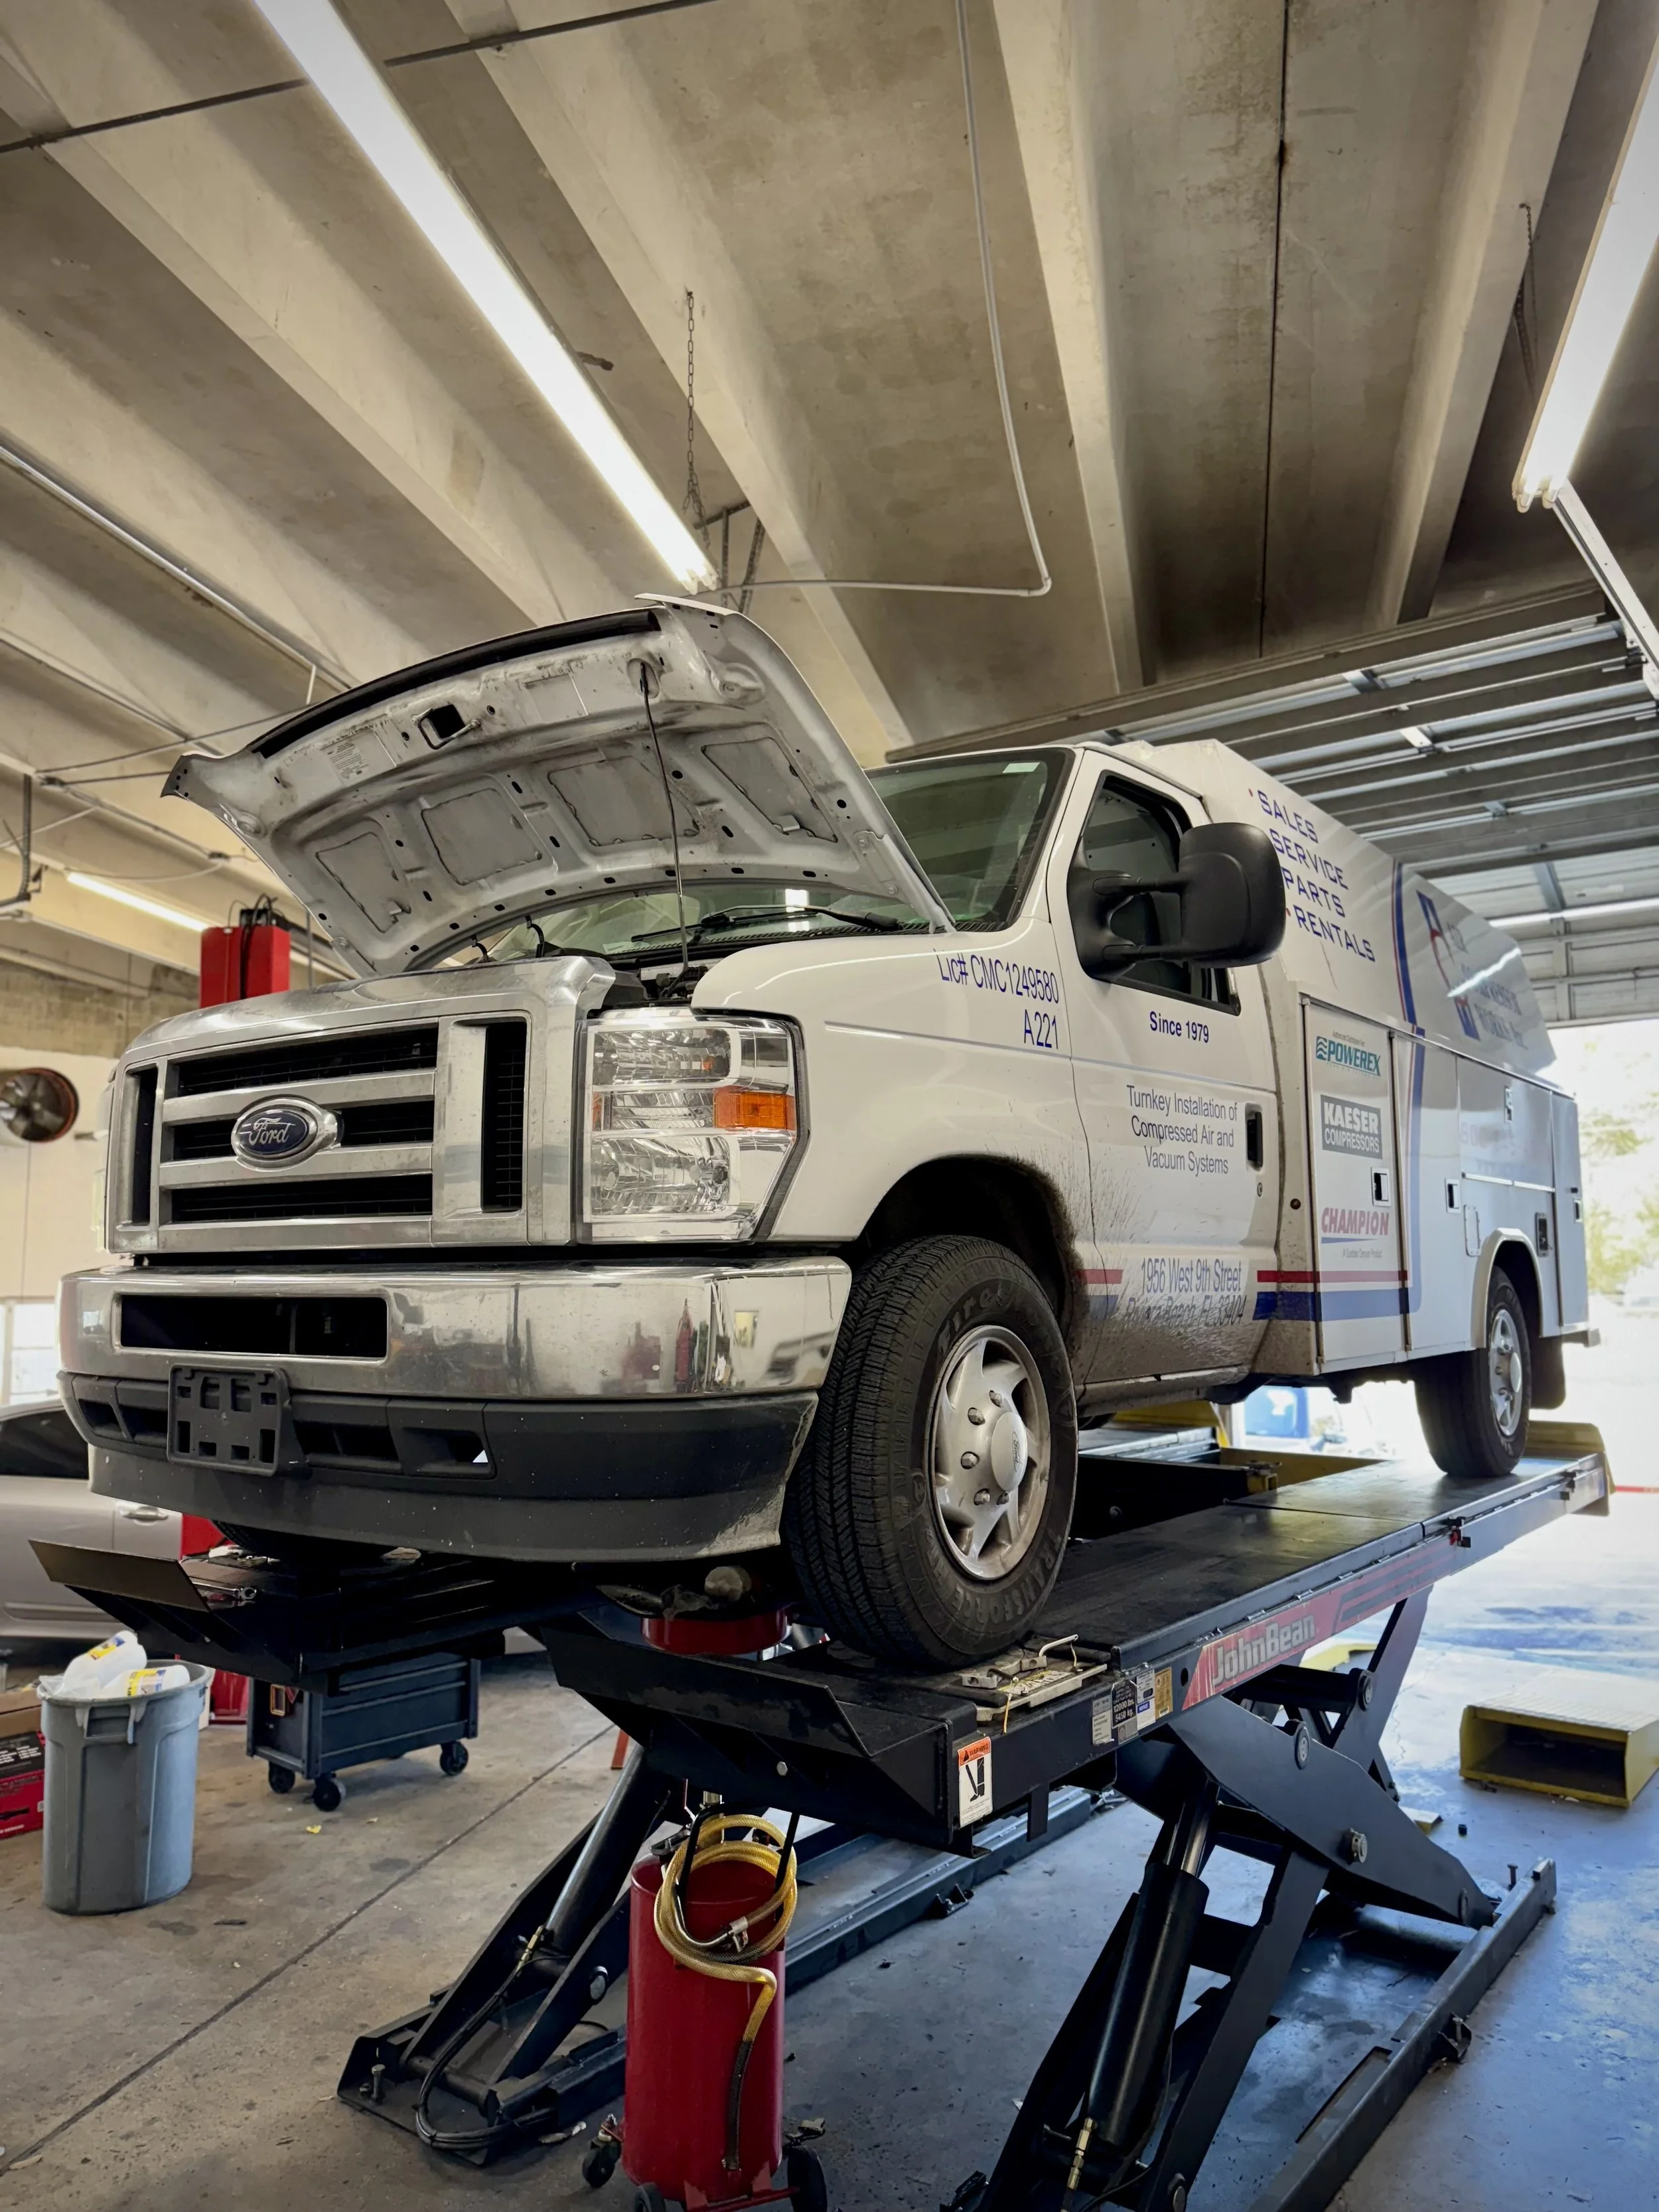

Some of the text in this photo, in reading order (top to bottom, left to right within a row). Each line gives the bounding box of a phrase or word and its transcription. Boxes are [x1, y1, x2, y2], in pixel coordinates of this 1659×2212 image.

[1258, 790, 1319, 844] SALES
[1269, 828, 1348, 890] SERVICE
[1281, 866, 1345, 918] PARTS
[1293, 905, 1375, 962] RENTALS
[933, 948, 1058, 1003] Lic# CMC1249580
[1150, 1011, 1208, 1043] Since 1979
[1327, 1039, 1380, 1076] POWEREX
[1127, 1084, 1237, 1121] Turnkey Installation of
[1324, 1101, 1379, 1134] KAESER
[249, 1118, 292, 1145] Ford
[1131, 1115, 1234, 1147] Compressed Air and
[1325, 1128, 1380, 1153] COMPRESSORS
[1144, 1145, 1228, 1177] Vacuum Systems
[1321, 1207, 1390, 1236] CHAMPION
[1141, 1258, 1241, 1294] 1956 West 9th Street
